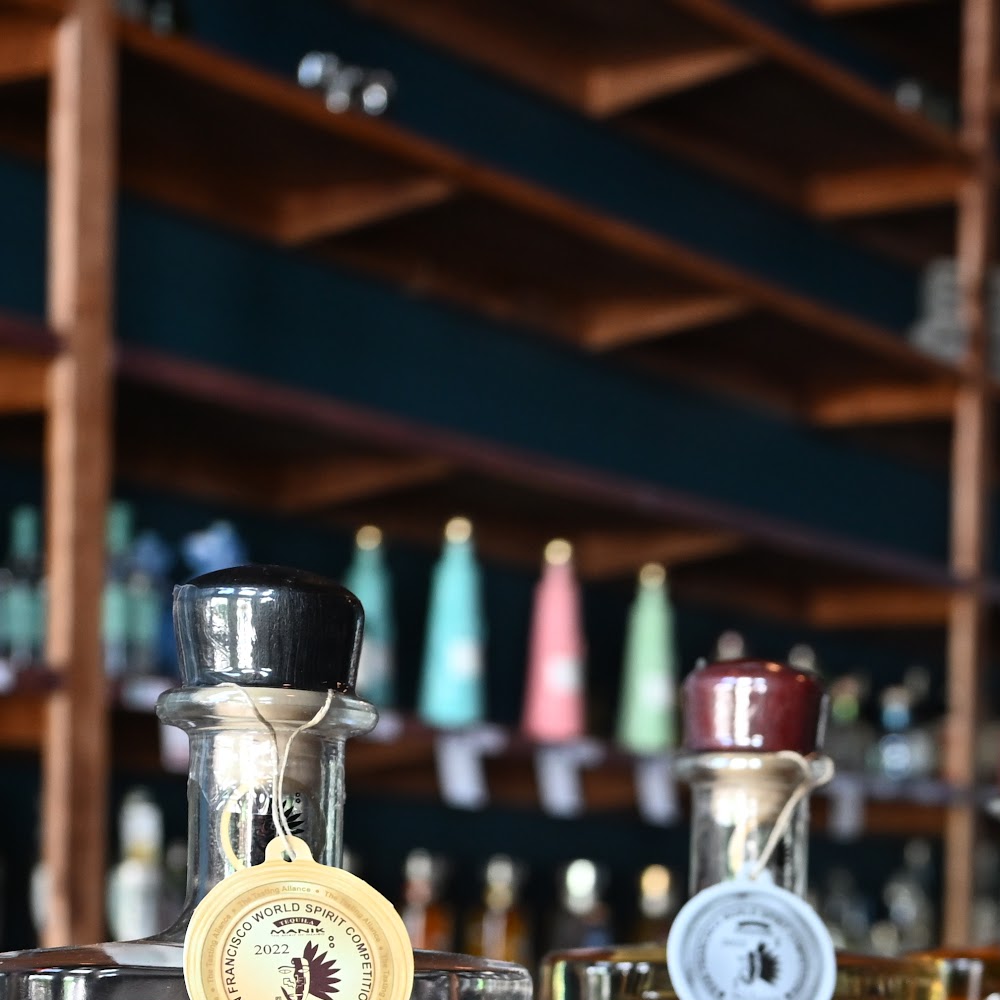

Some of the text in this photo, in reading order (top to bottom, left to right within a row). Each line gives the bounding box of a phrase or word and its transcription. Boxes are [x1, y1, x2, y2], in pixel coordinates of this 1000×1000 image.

[279, 917, 314, 926] TEQUILA
[270, 927, 325, 935] MANIK
[225, 921, 253, 994] FRANCISCO
[252, 902, 300, 923] WORLD
[304, 903, 347, 927] SPIRIT
[254, 943, 290, 955] 2022
